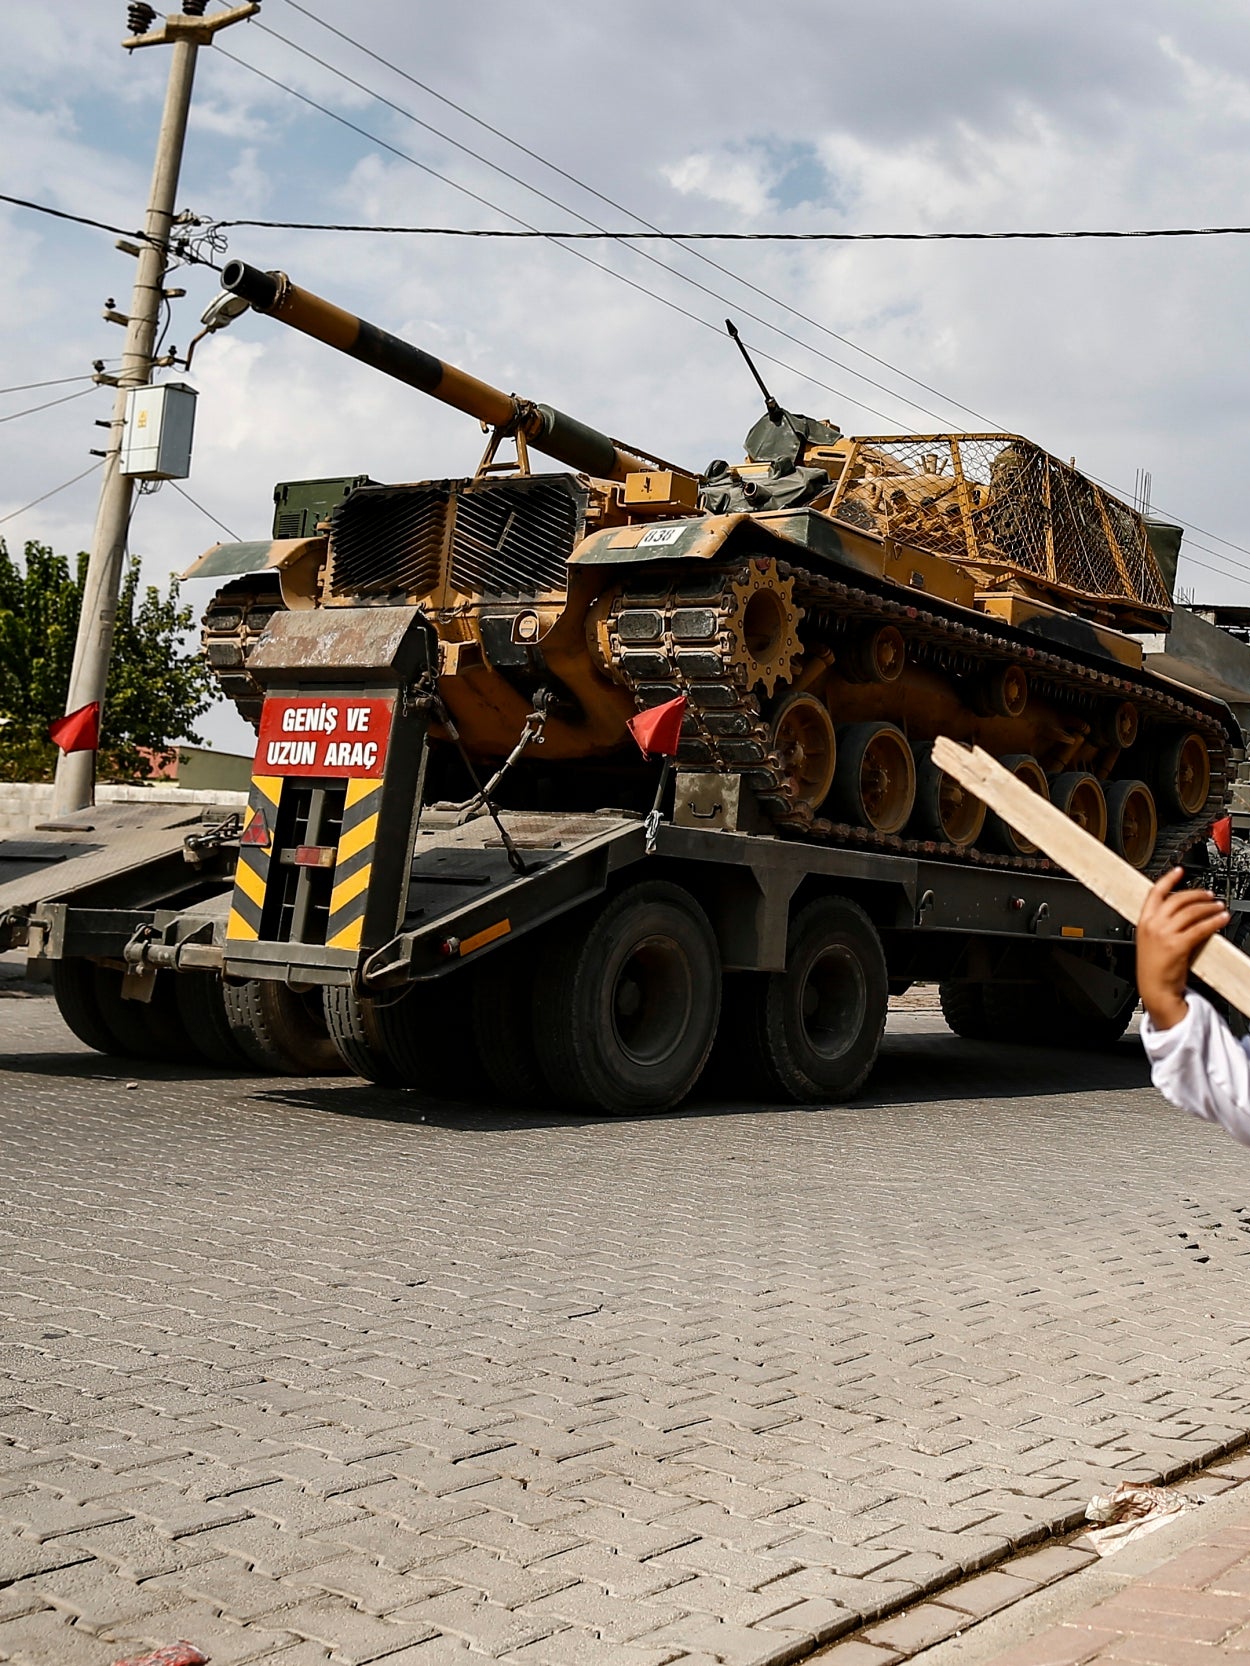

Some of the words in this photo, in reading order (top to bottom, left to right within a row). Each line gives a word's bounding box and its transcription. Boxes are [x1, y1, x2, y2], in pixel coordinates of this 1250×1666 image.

[282, 702, 339, 735] GENİŞ
[346, 707, 371, 732] VE
[266, 741, 317, 765] UZUN
[323, 742, 378, 770] ARAÇ
